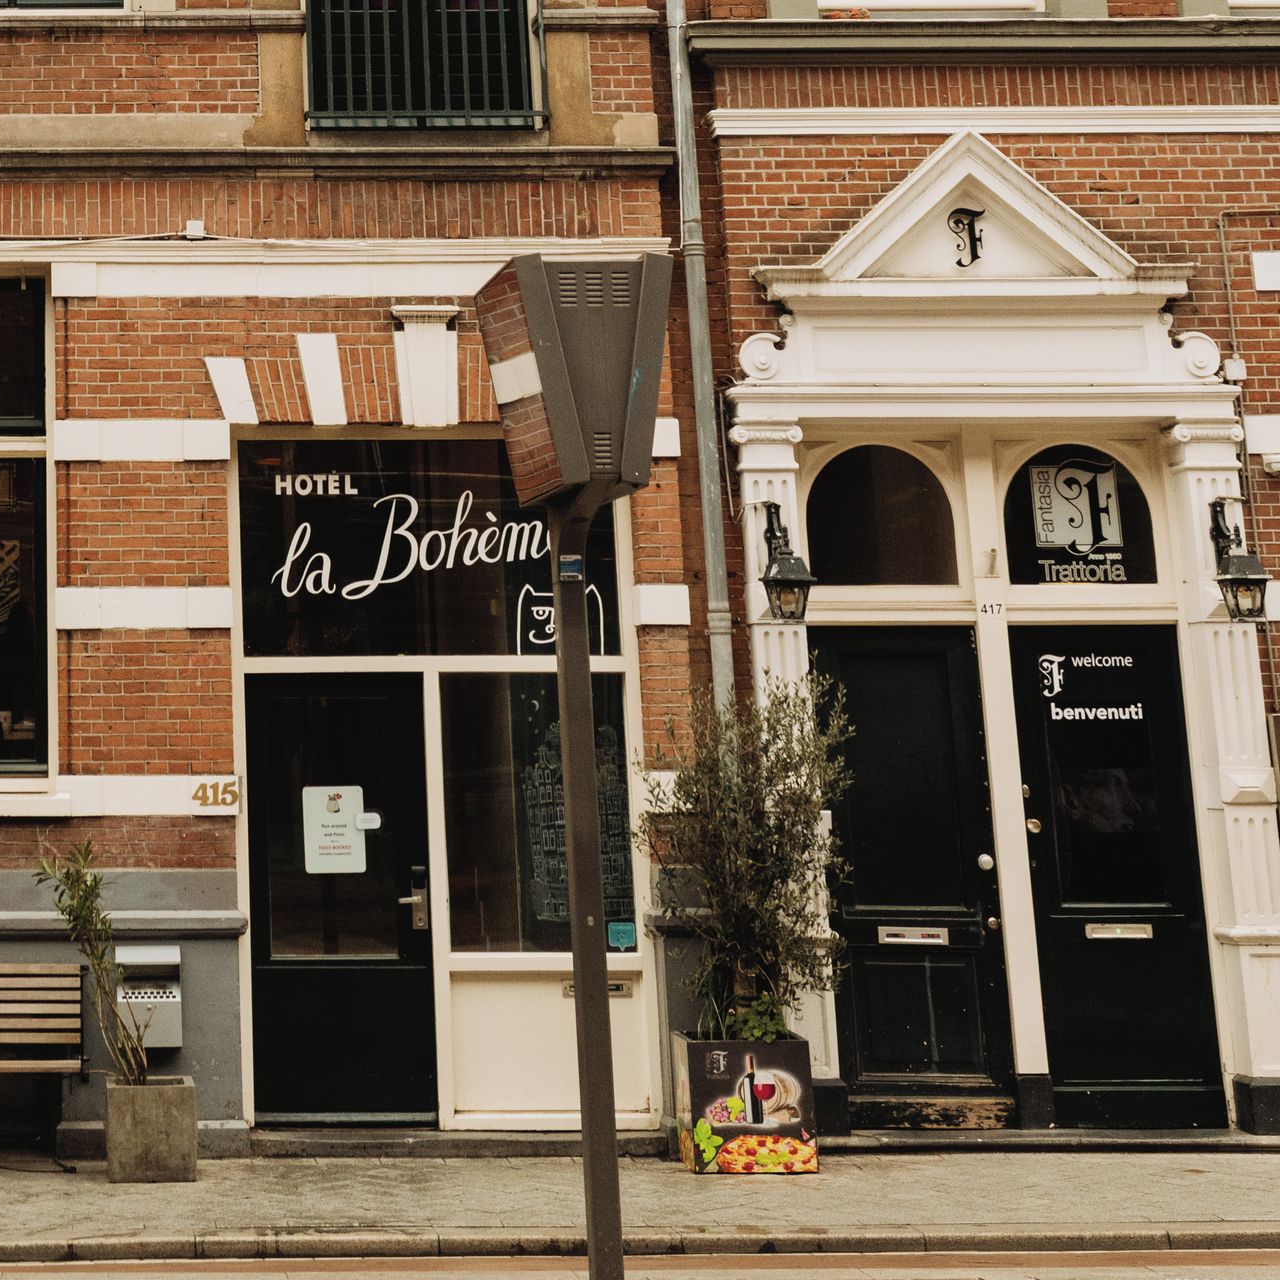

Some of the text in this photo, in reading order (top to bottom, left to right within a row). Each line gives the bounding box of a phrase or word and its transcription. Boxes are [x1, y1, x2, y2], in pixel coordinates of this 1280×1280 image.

[274, 473, 359, 496] HOTEL
[1034, 469, 1056, 544] Fantasia
[270, 490, 551, 600] la Bohèm
[1037, 559, 1127, 582] Trattoria
[980, 603, 1003, 615] 417
[1071, 652, 1133, 668] welcome
[1050, 702, 1144, 721] benvenuti
[192, 780, 239, 807] 415
